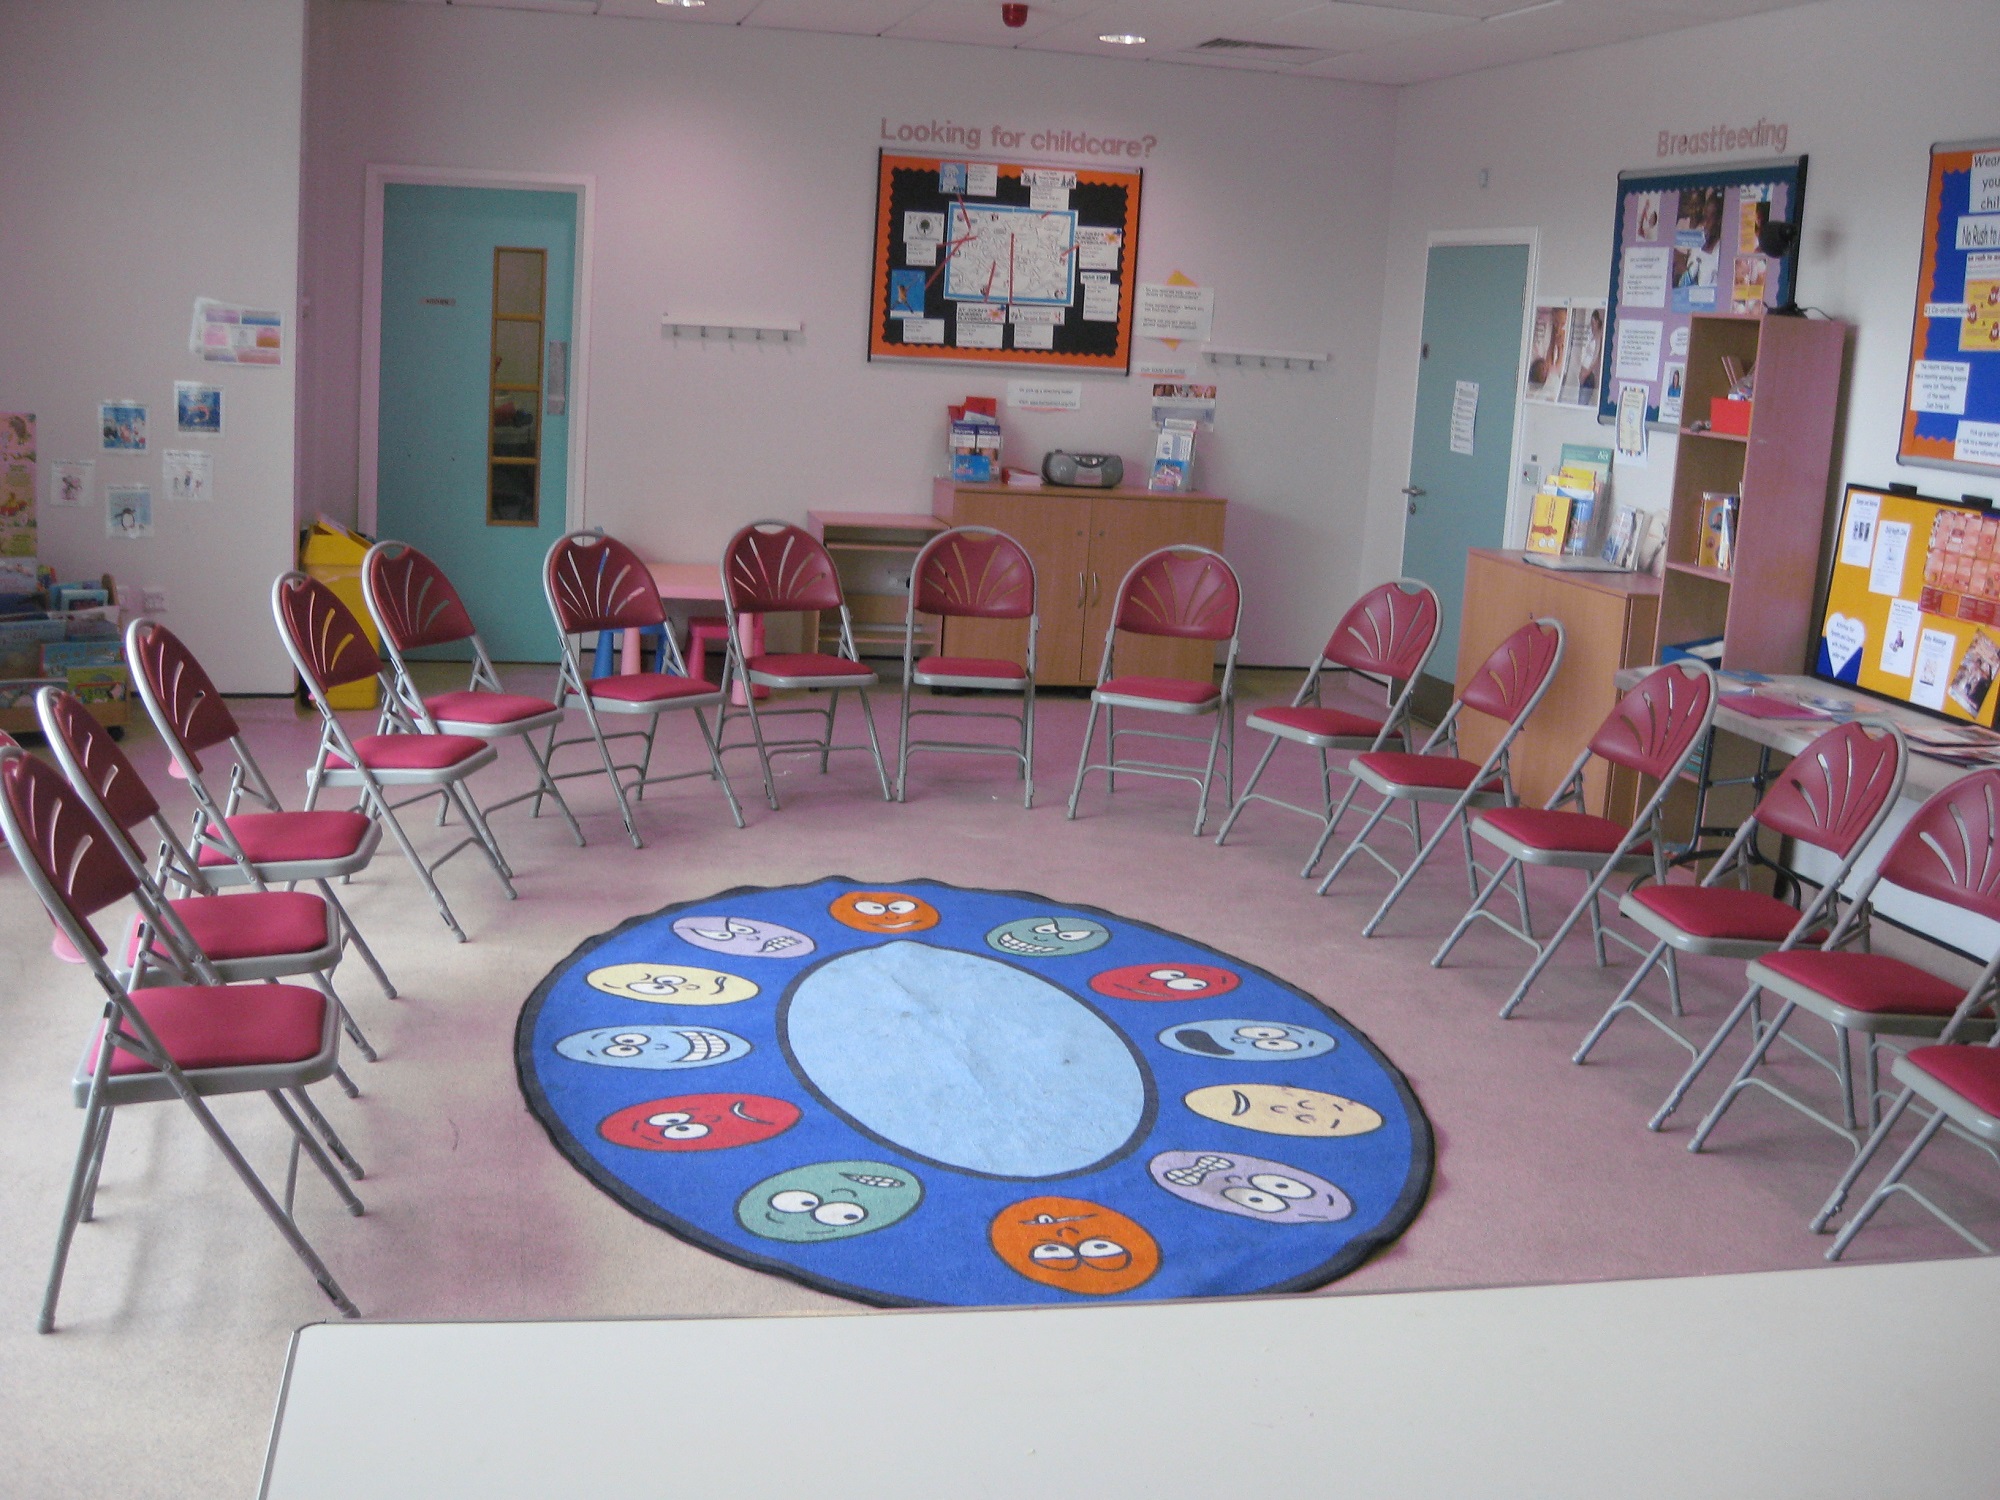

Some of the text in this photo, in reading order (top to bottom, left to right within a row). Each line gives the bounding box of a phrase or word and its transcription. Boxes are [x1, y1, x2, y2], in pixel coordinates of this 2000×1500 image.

[881, 118, 1158, 159] Looking for childcare?
[1657, 117, 1788, 157] Breastfeeding
[1961, 224, 1997, 246] No Rush to
